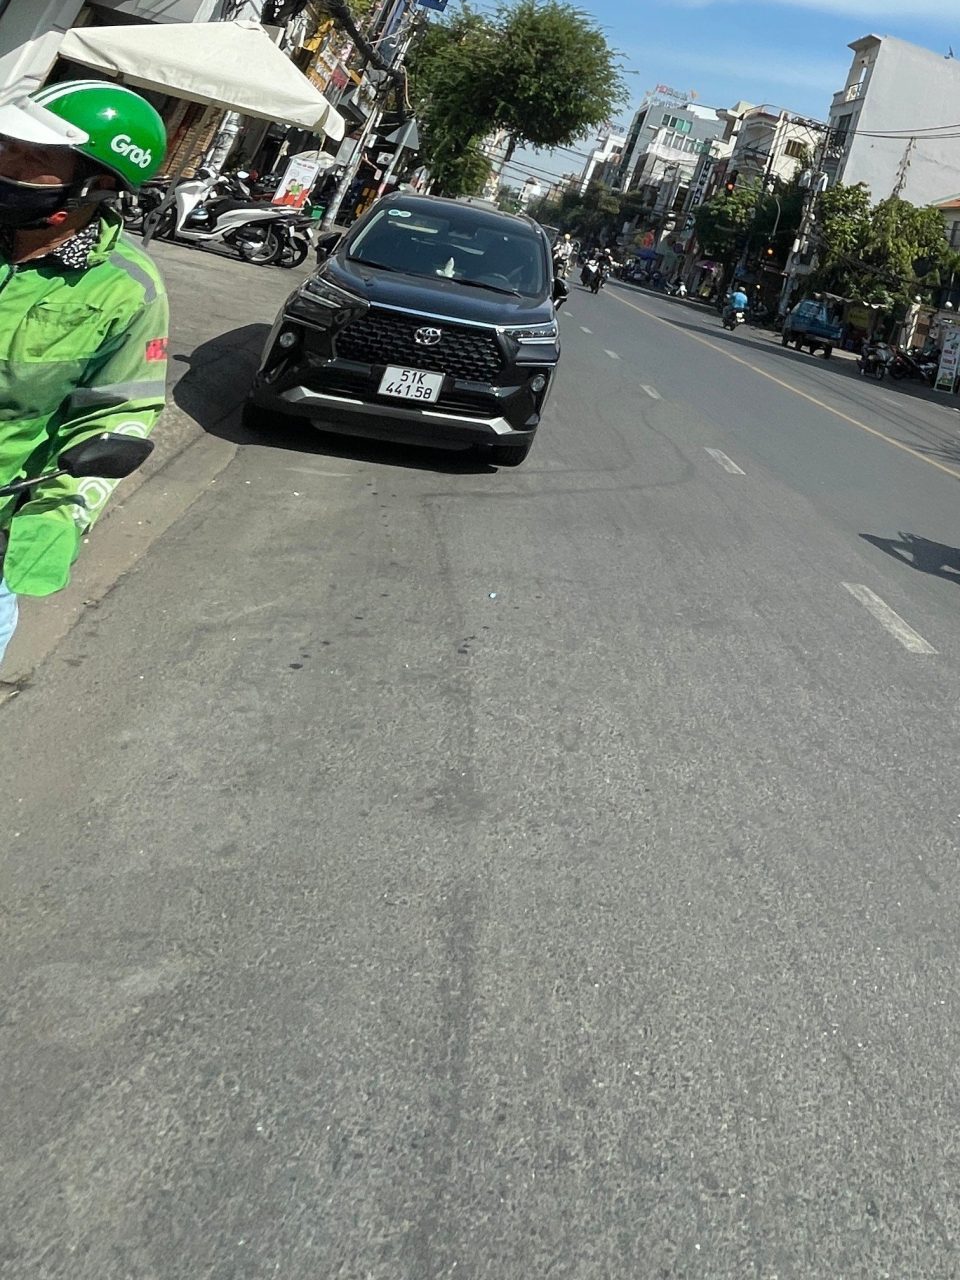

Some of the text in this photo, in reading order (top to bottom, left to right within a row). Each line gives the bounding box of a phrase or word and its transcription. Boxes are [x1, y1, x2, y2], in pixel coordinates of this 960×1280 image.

[111, 134, 152, 169] Grab
[400, 370, 427, 385] 51K
[385, 381, 433, 400] 441.58
